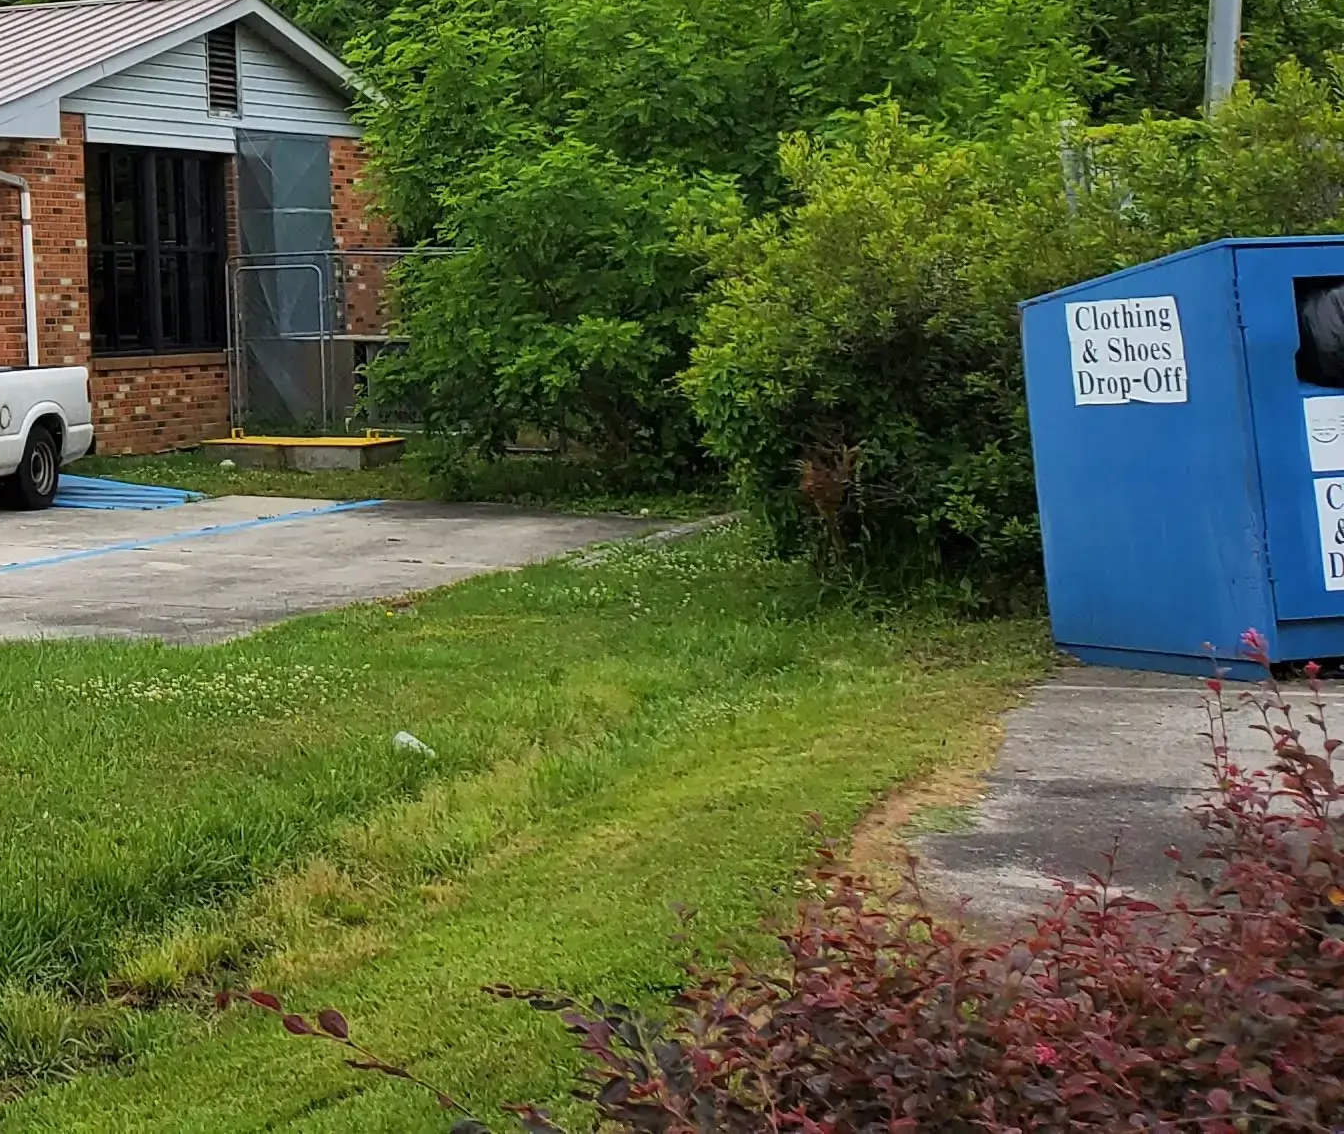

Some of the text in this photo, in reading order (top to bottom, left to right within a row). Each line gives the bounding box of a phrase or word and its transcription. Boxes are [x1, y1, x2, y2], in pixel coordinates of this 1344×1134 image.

[1075, 303, 1172, 331] Clothing
[1082, 337, 1172, 364] & Shoes
[1077, 366, 1183, 399] Drop-Off
